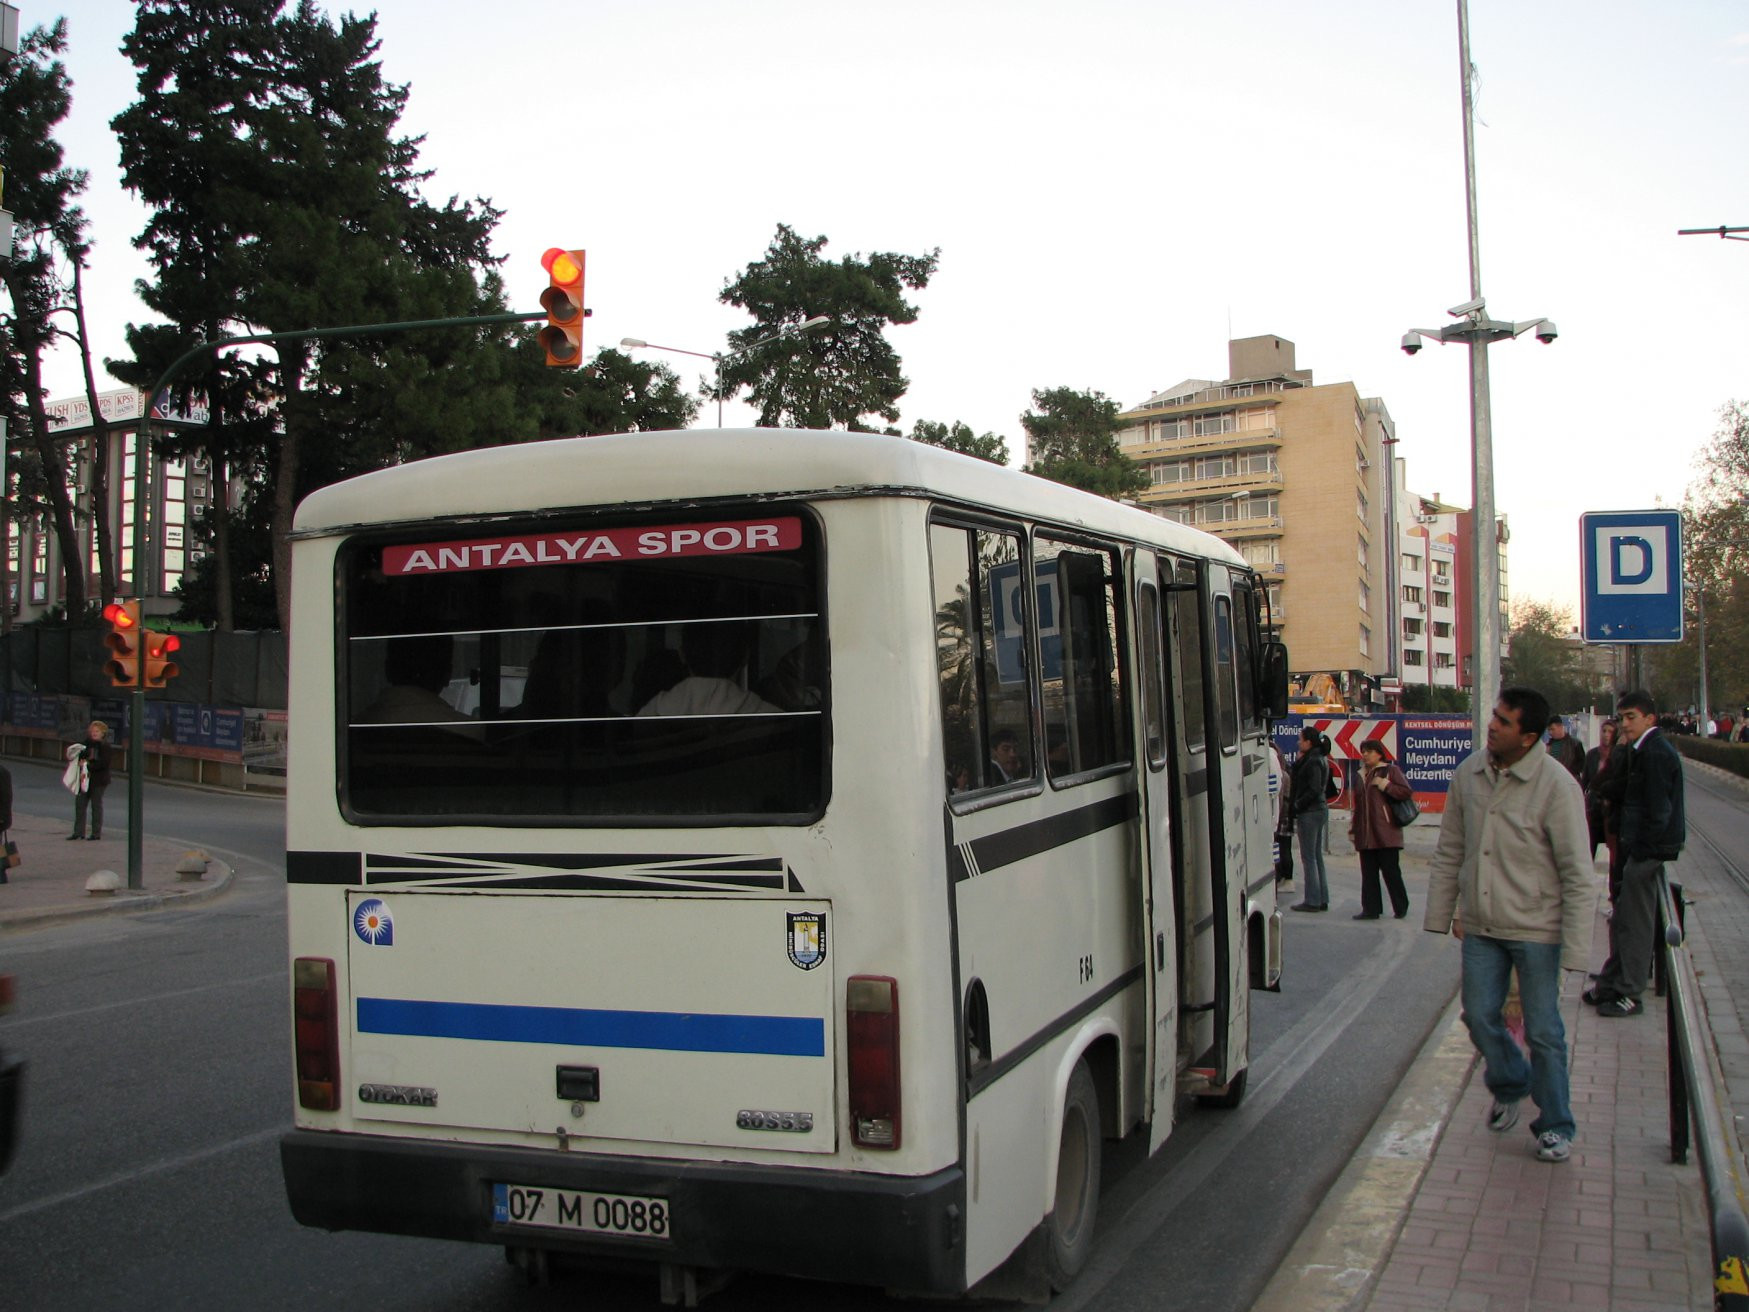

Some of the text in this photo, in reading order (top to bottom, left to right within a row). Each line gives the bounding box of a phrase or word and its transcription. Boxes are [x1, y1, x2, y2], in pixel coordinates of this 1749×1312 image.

[402, 524, 781, 573] ANTALYA SPOR
[1610, 536, 1653, 586] D
[1405, 736, 1473, 753] Cumhuriye
[1406, 752, 1456, 768] Meydanı
[1406, 768, 1455, 781] düzenle
[358, 1083, 439, 1107] OTOKAR
[509, 1189, 666, 1235] 07 M 0088
